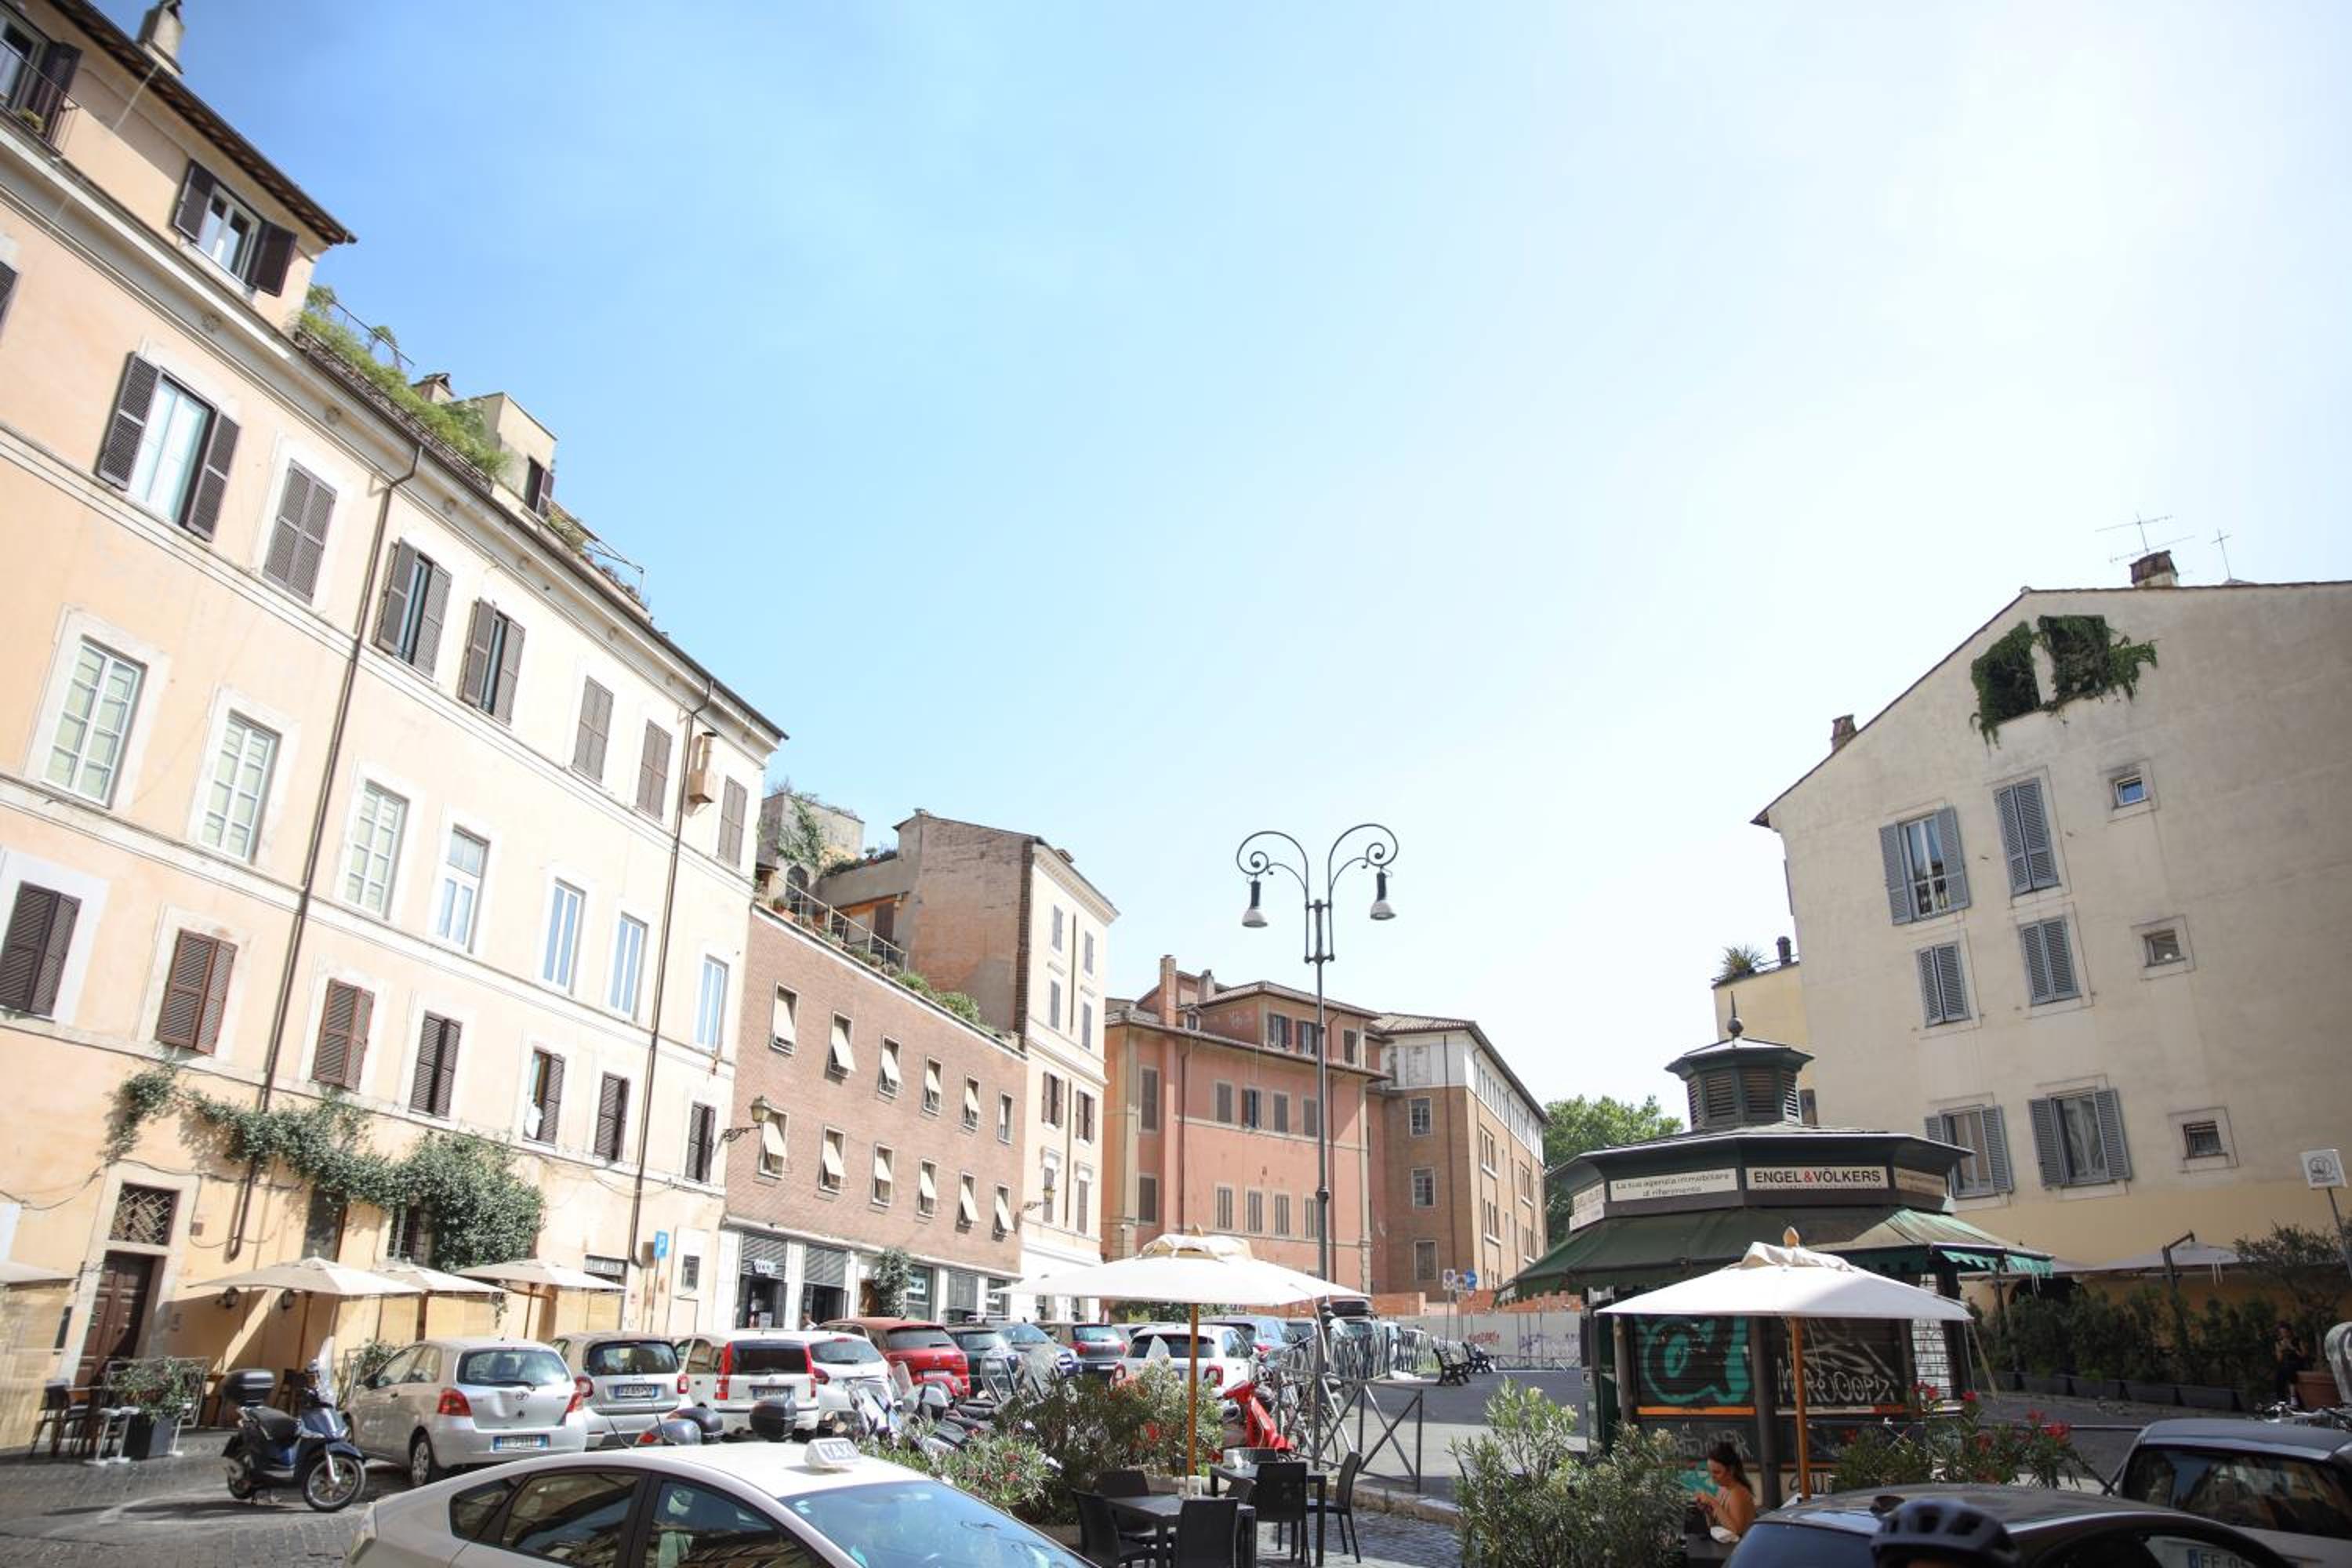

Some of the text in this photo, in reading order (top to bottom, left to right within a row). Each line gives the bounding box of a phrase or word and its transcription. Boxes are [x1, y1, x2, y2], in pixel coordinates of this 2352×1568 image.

[1753, 1167, 1882, 1184] ENGEL&VÖLKERS
[656, 1234, 666, 1255] P
[818, 1441, 858, 1459] TAXI
